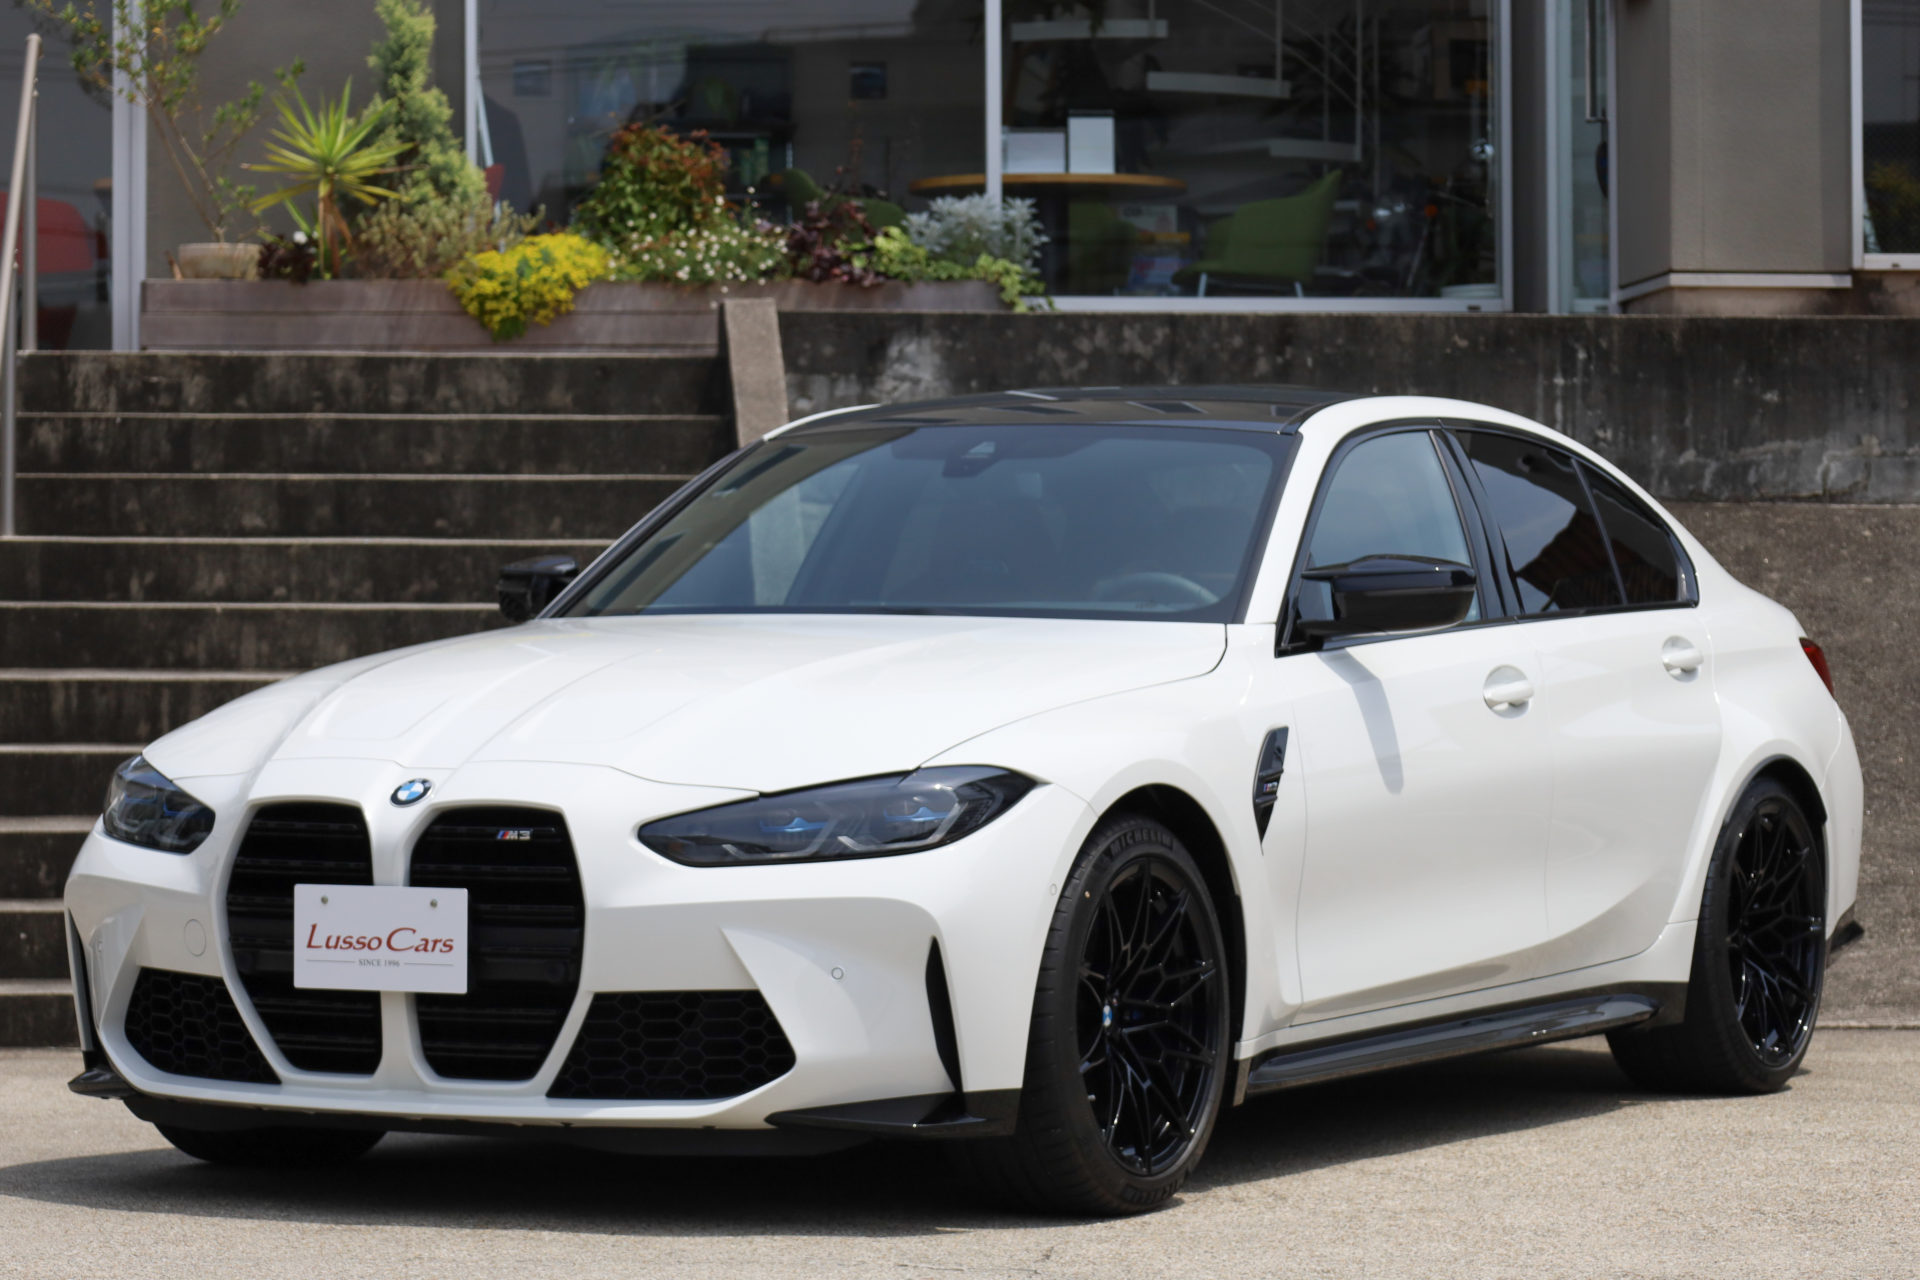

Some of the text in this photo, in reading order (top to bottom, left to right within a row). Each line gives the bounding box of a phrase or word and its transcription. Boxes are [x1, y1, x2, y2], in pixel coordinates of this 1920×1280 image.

[503, 829, 531, 840] M3
[306, 923, 454, 953] Lusso Cars
[358, 958, 381, 967] SINCE
